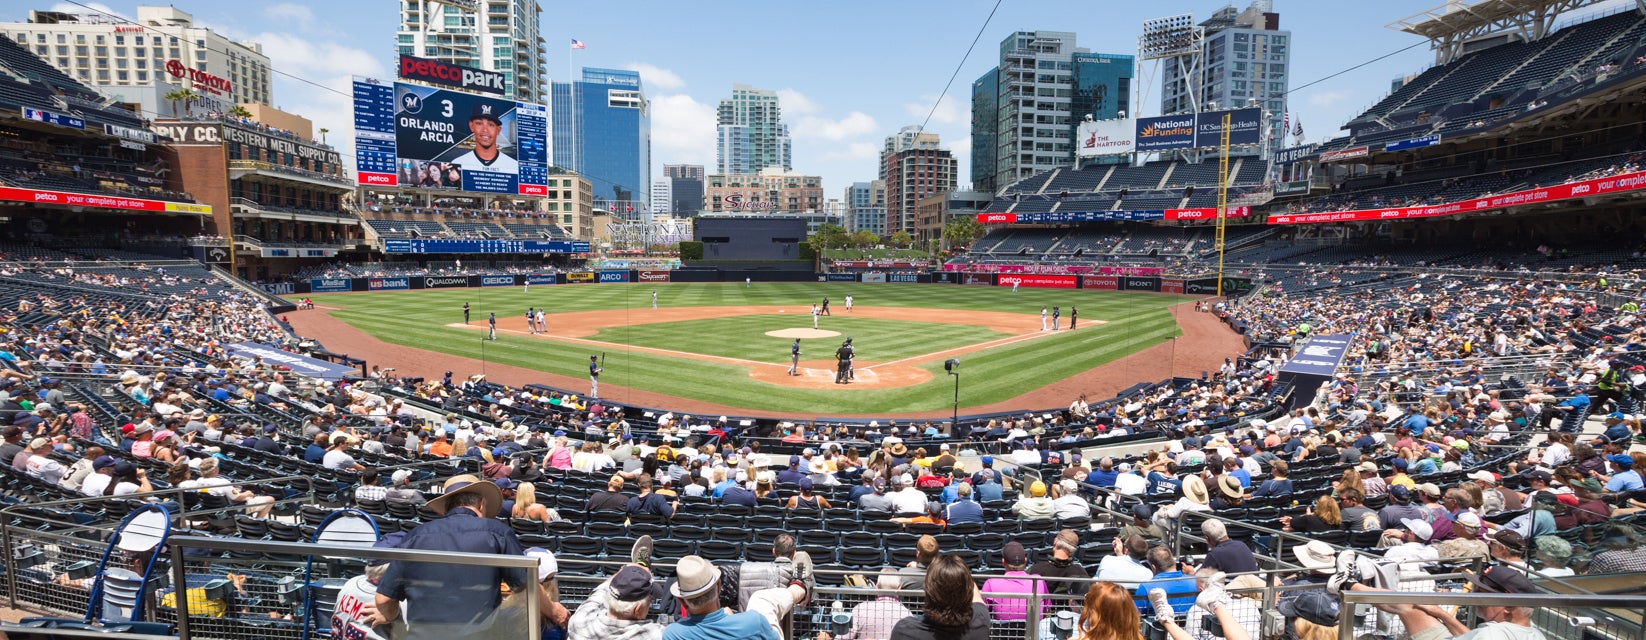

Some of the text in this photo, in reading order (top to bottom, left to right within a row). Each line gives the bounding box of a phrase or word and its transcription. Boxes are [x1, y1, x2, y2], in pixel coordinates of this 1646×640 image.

[188, 68, 232, 93] TOYOTA
[401, 57, 504, 90] petco park
[441, 100, 454, 118] 3
[400, 117, 454, 133] ORLANDO
[1154, 119, 1192, 129] National
[151, 126, 222, 142] PLY CO.
[420, 131, 454, 144] ARCIA
[1154, 128, 1192, 136] Funding
[224, 126, 267, 148] WESTERN
[271, 139, 297, 155] METAL
[299, 146, 326, 161] SUPPLY
[328, 153, 340, 164] CO.
[1276, 152, 1288, 163] LAS
[368, 174, 389, 183] petco
[1571, 172, 1646, 195] petco your complet
[35, 192, 58, 200] petco
[67, 196, 84, 204] your
[85, 197, 116, 207] complete
[724, 194, 776, 211] Sycuan
[1504, 195, 1524, 204] complete
[1525, 194, 1533, 202] pet
[1534, 191, 1548, 199] store
[606, 224, 691, 234] NATIONAL
[426, 278, 466, 287] QUALCOMM
[641, 272, 668, 280] Sycuan
